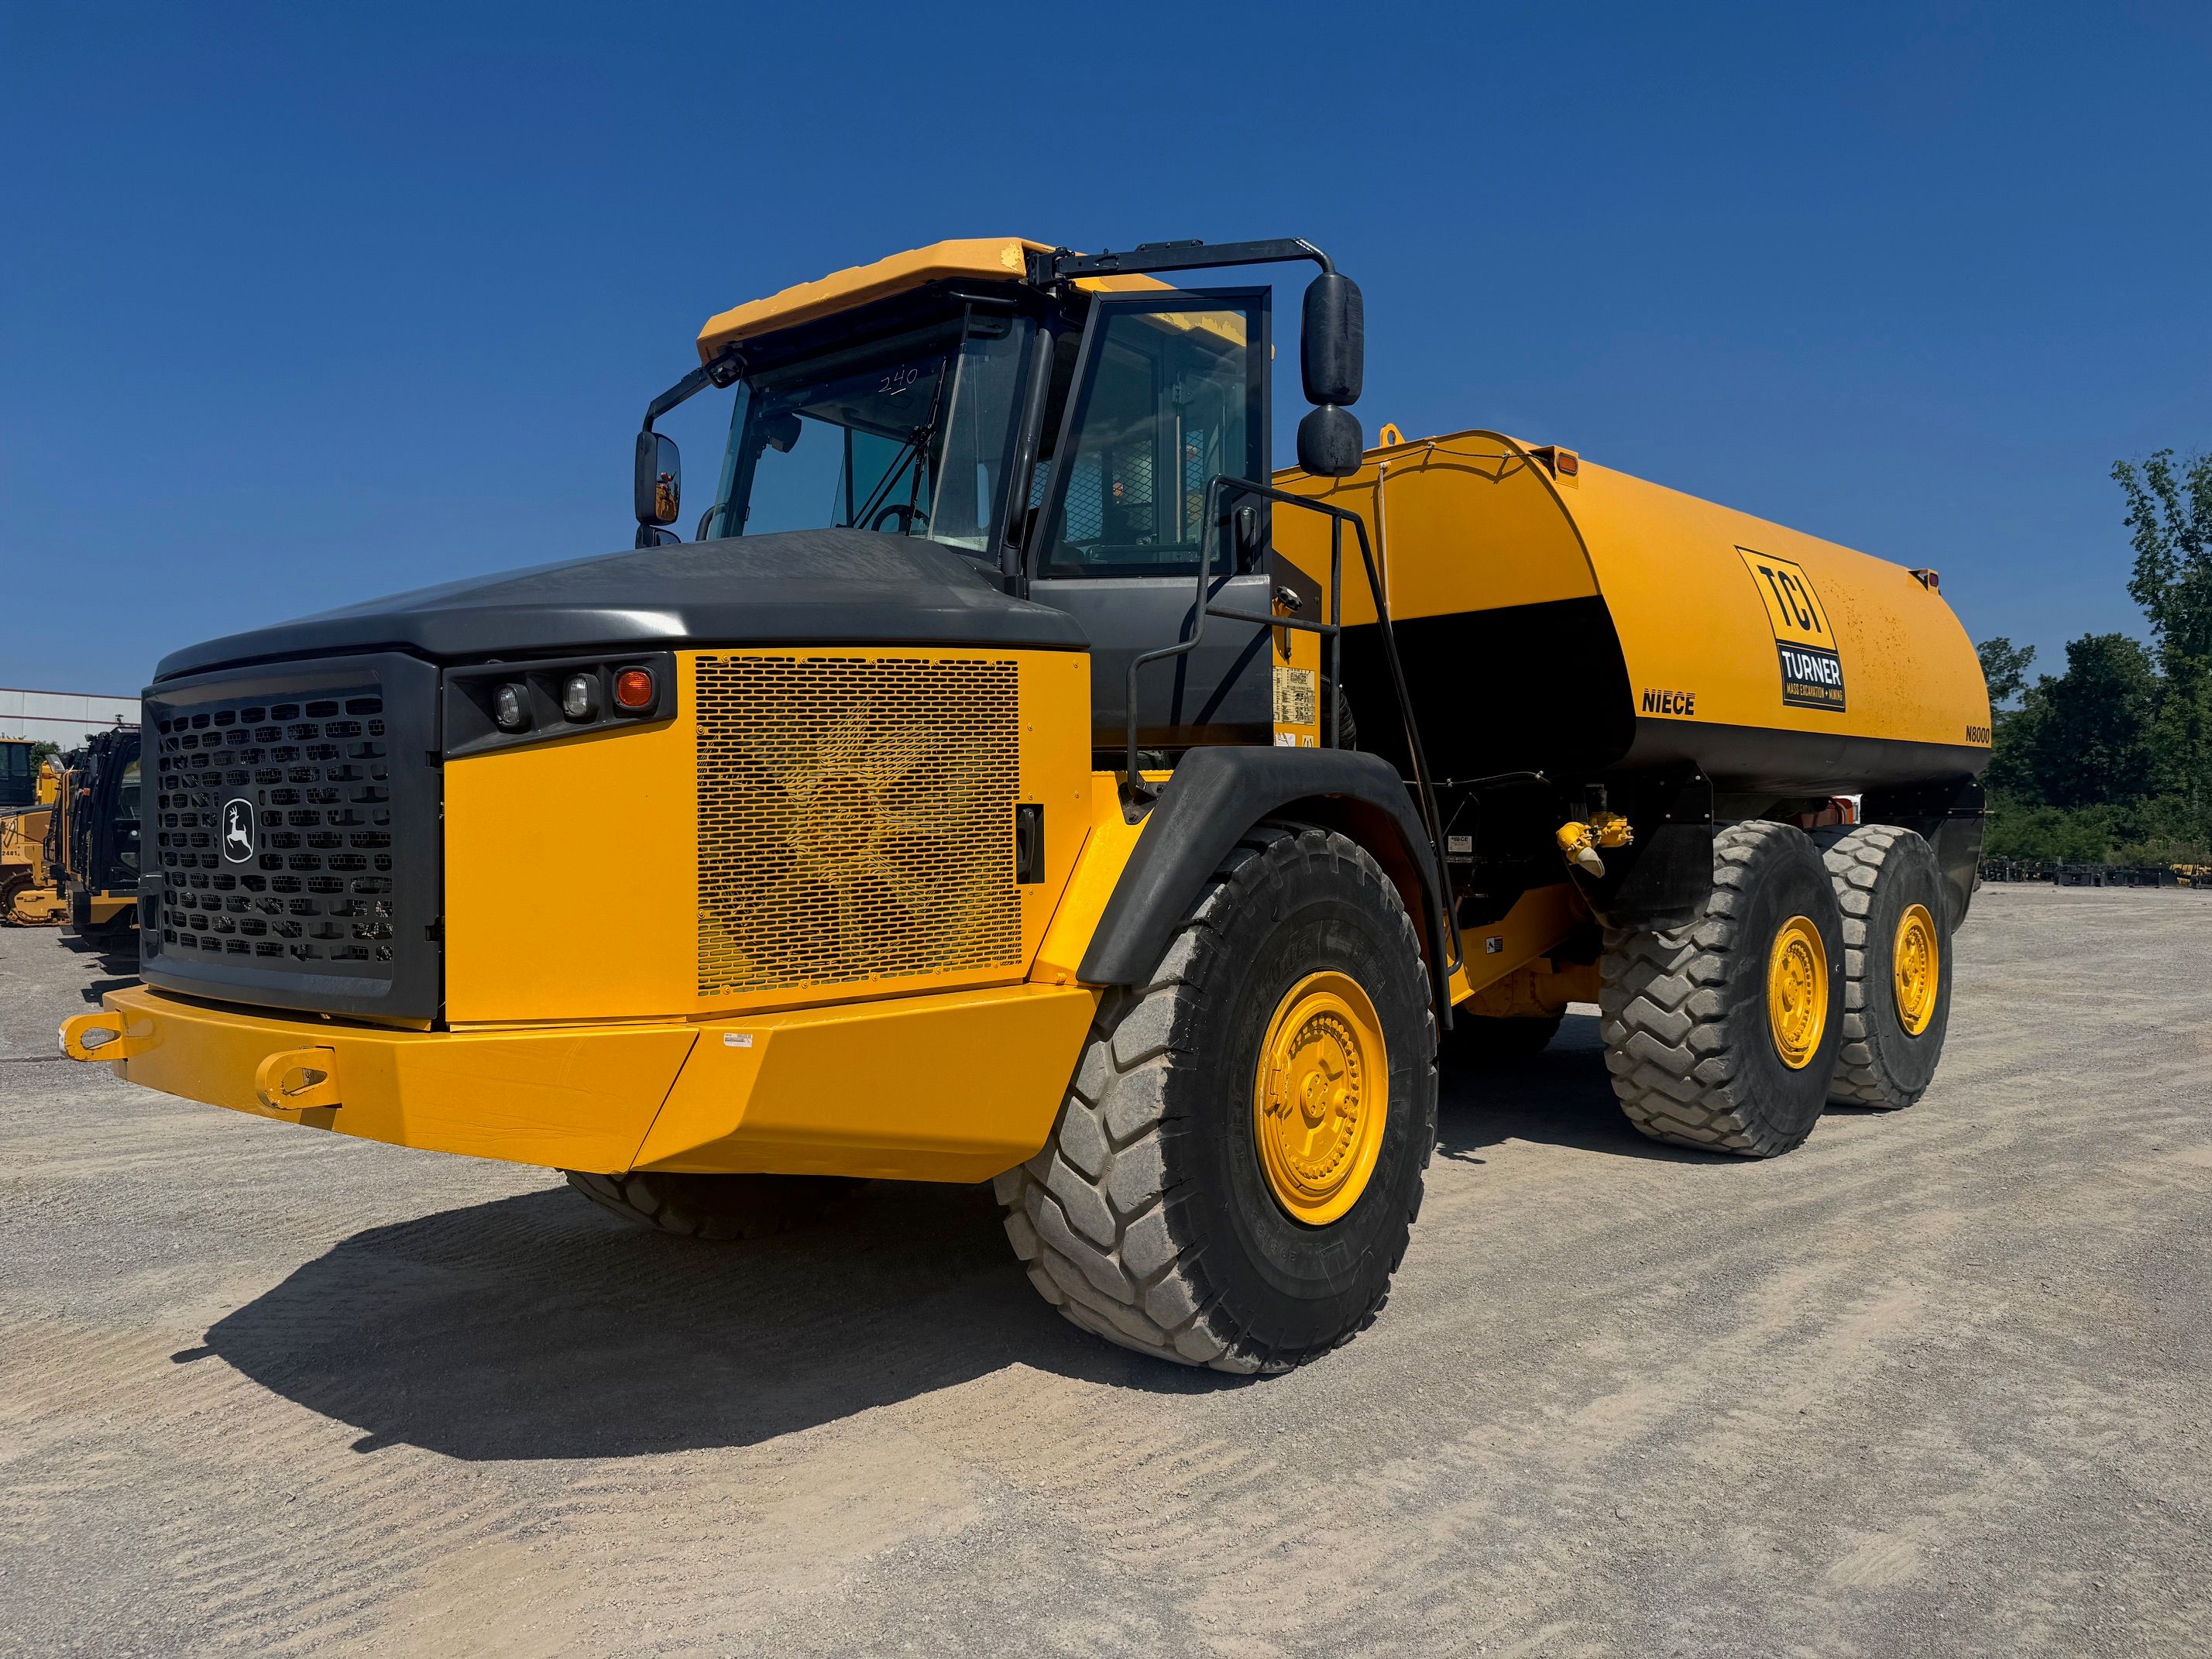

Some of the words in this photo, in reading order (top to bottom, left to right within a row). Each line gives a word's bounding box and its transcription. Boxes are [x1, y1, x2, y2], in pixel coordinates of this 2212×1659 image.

[878, 369, 918, 393] 240
[1756, 565, 1822, 634] TCI
[1781, 651, 1842, 686] TURNER
[1642, 688, 1695, 716] NIECE
[1786, 682, 1800, 696] MASS
[1800, 684, 1825, 699] EXCAVATION
[1829, 689, 1843, 702] MINING
[1966, 725, 1990, 744] N8000
